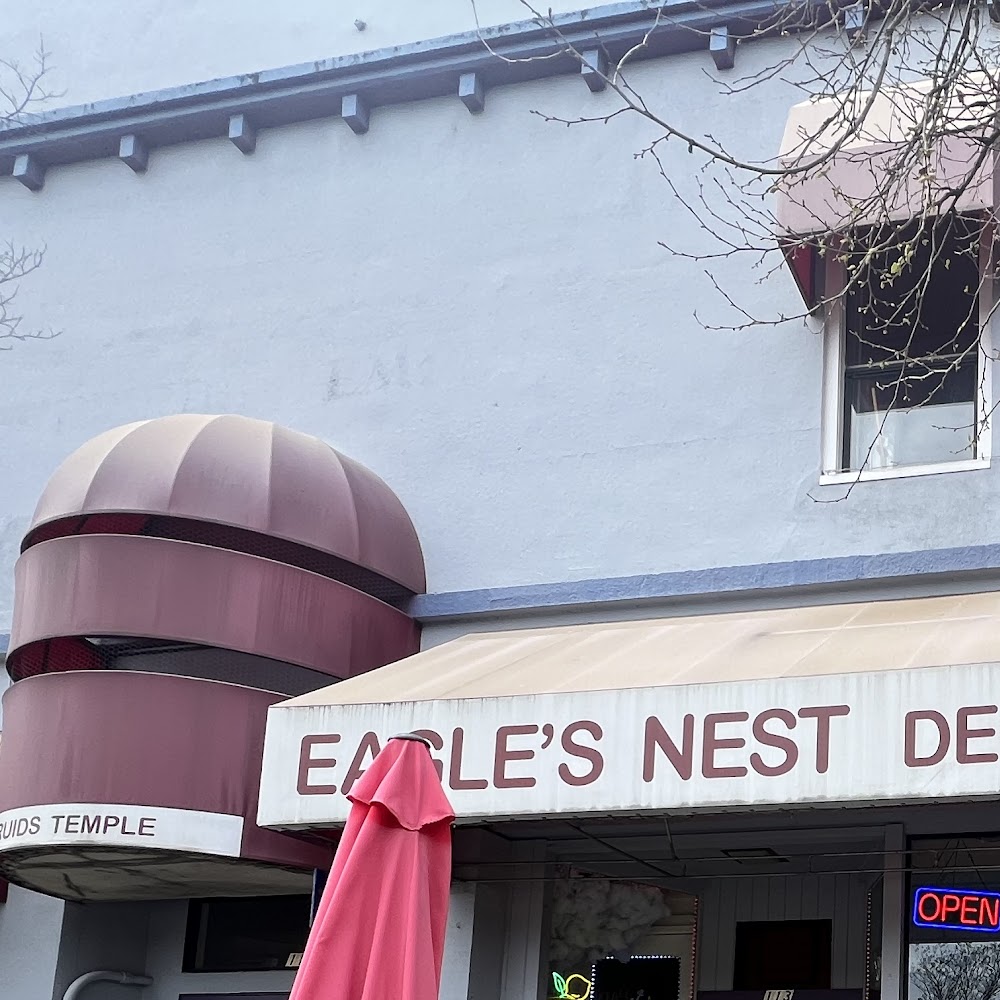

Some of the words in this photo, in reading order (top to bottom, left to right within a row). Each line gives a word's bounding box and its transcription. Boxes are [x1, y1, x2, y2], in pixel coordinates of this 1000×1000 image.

[643, 704, 850, 782] NEST
[51, 815, 157, 836] TEMPLE
[918, 892, 1000, 926] OPEN
